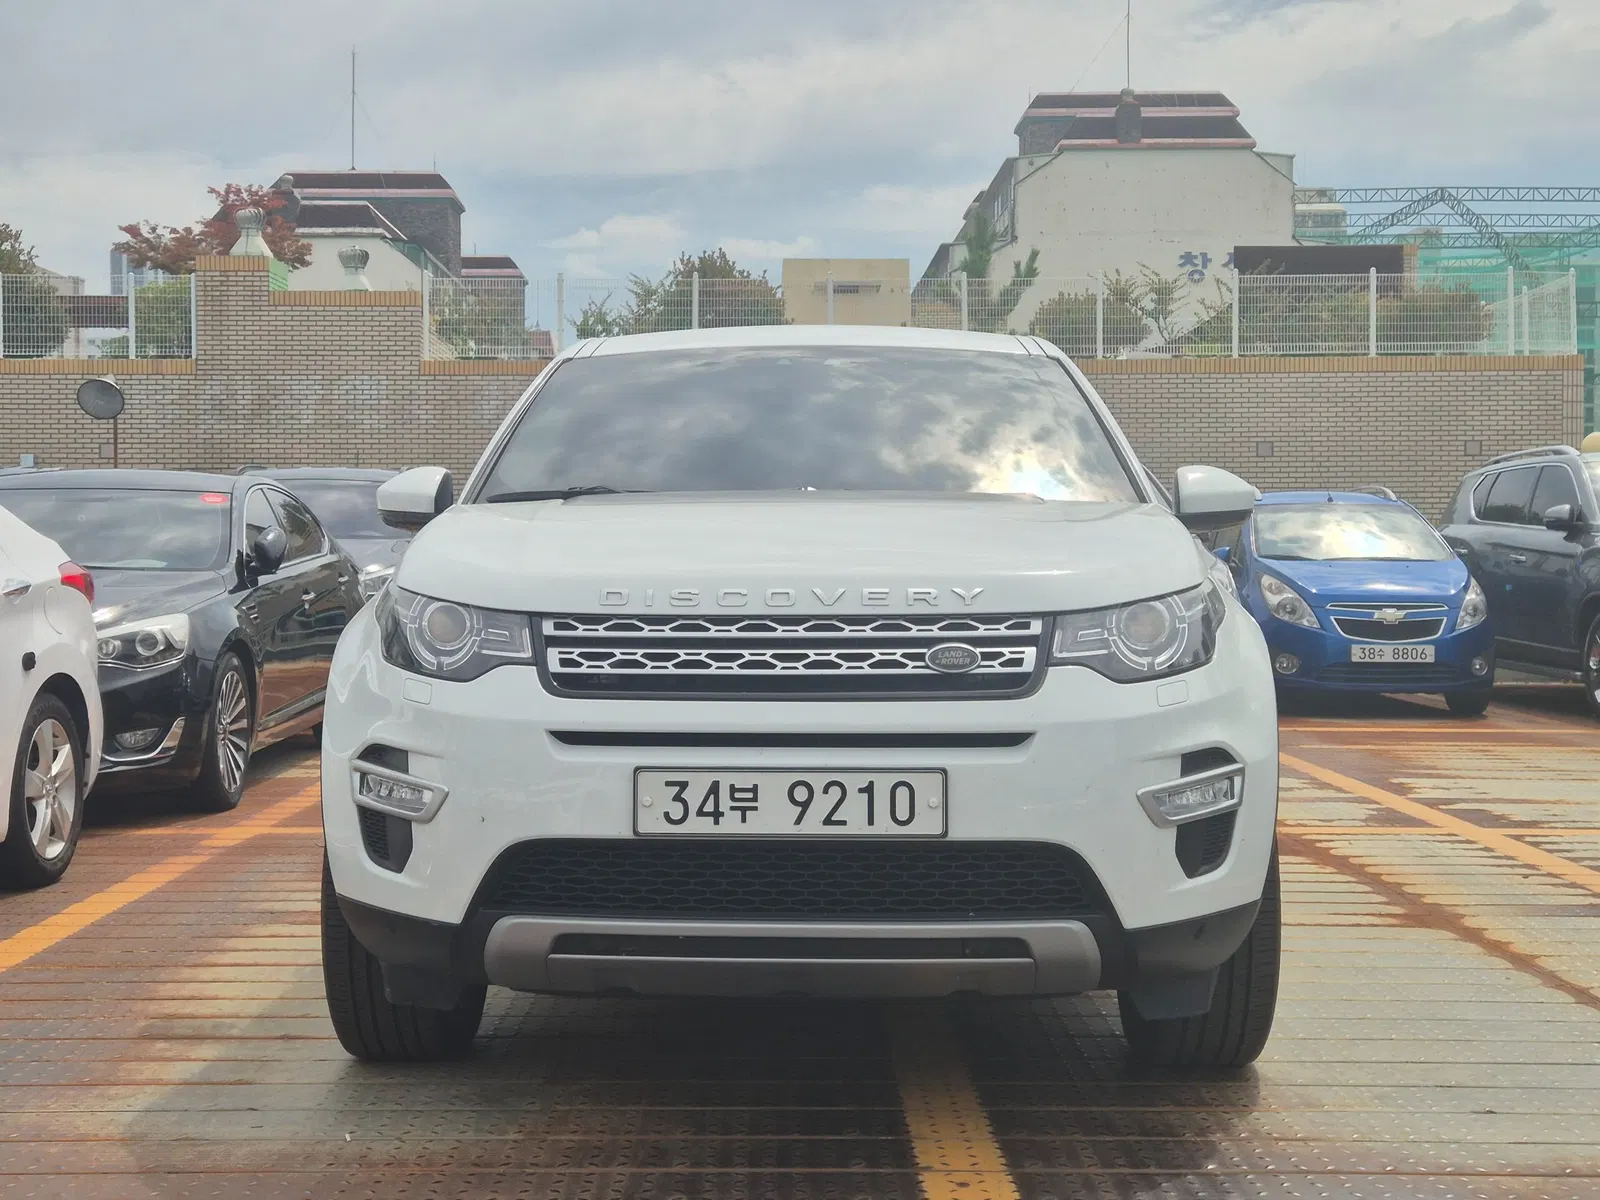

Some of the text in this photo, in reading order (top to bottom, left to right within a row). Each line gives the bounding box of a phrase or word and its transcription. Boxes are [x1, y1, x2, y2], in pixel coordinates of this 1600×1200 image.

[600, 587, 984, 606] DISCOVERY
[1358, 647, 1428, 660] 38수 8806
[662, 779, 916, 827] 34부 9210
